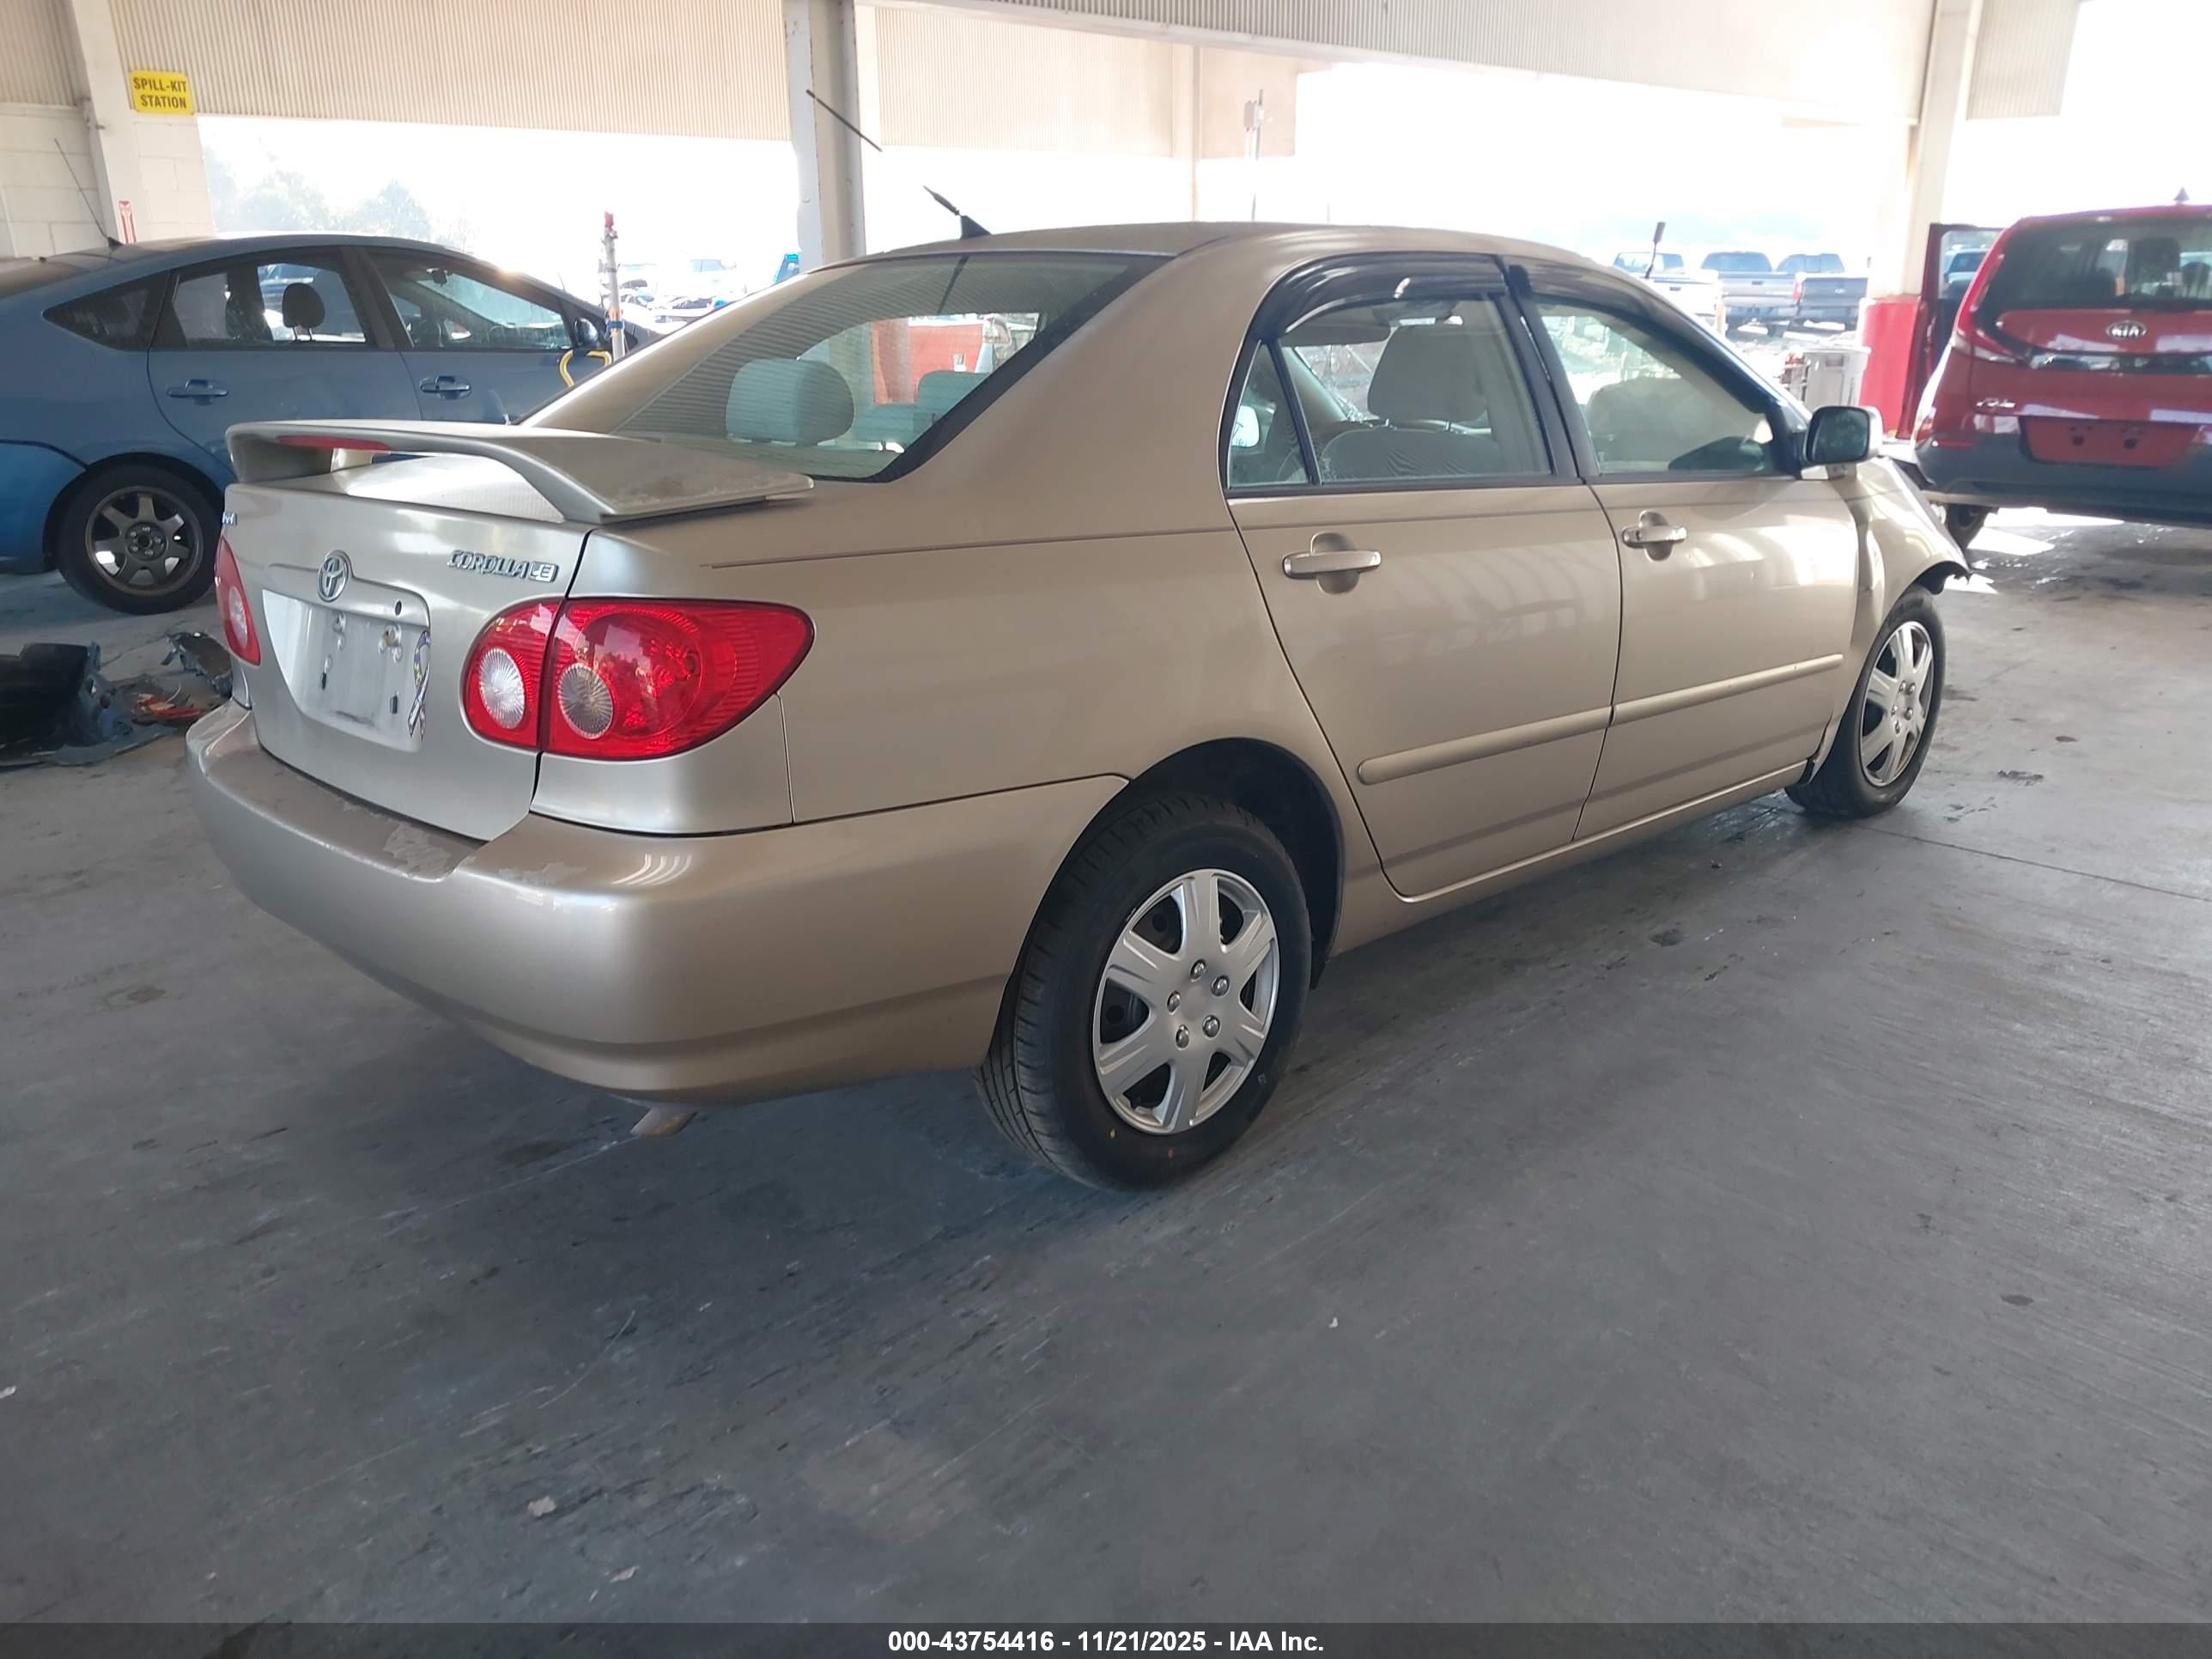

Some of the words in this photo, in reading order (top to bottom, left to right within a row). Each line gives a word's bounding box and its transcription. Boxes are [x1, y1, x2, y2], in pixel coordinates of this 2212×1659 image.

[133, 77, 186, 93] SPILL-KIT
[140, 94, 186, 109] STATION
[2112, 325, 2139, 337] KIA
[447, 550, 530, 579] COROLLA
[530, 562, 555, 580] LE
